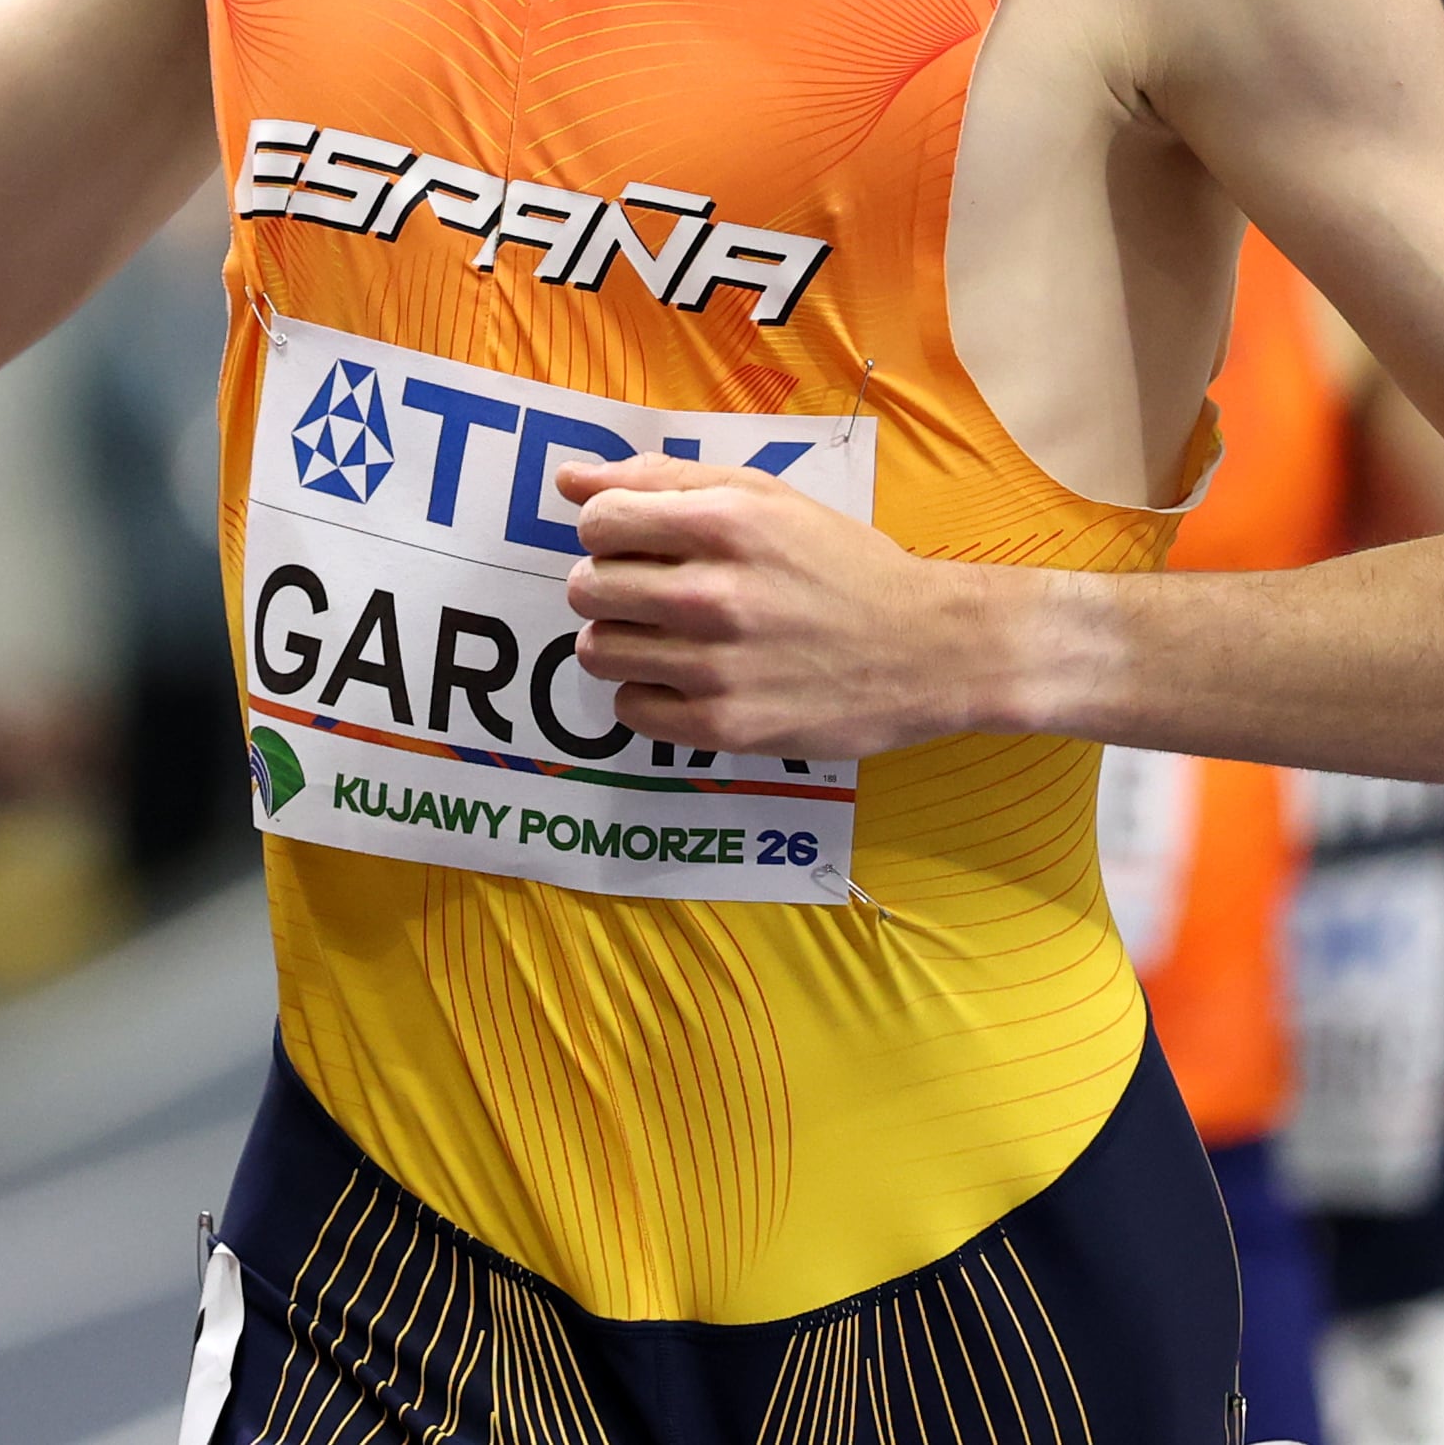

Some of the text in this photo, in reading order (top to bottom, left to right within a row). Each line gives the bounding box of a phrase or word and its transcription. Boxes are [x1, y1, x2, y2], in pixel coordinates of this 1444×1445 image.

[235, 119, 833, 326] ESPAÑA
[255, 564, 810, 773] GARC
[334, 773, 818, 866] KUJAWY POMORZE 26
